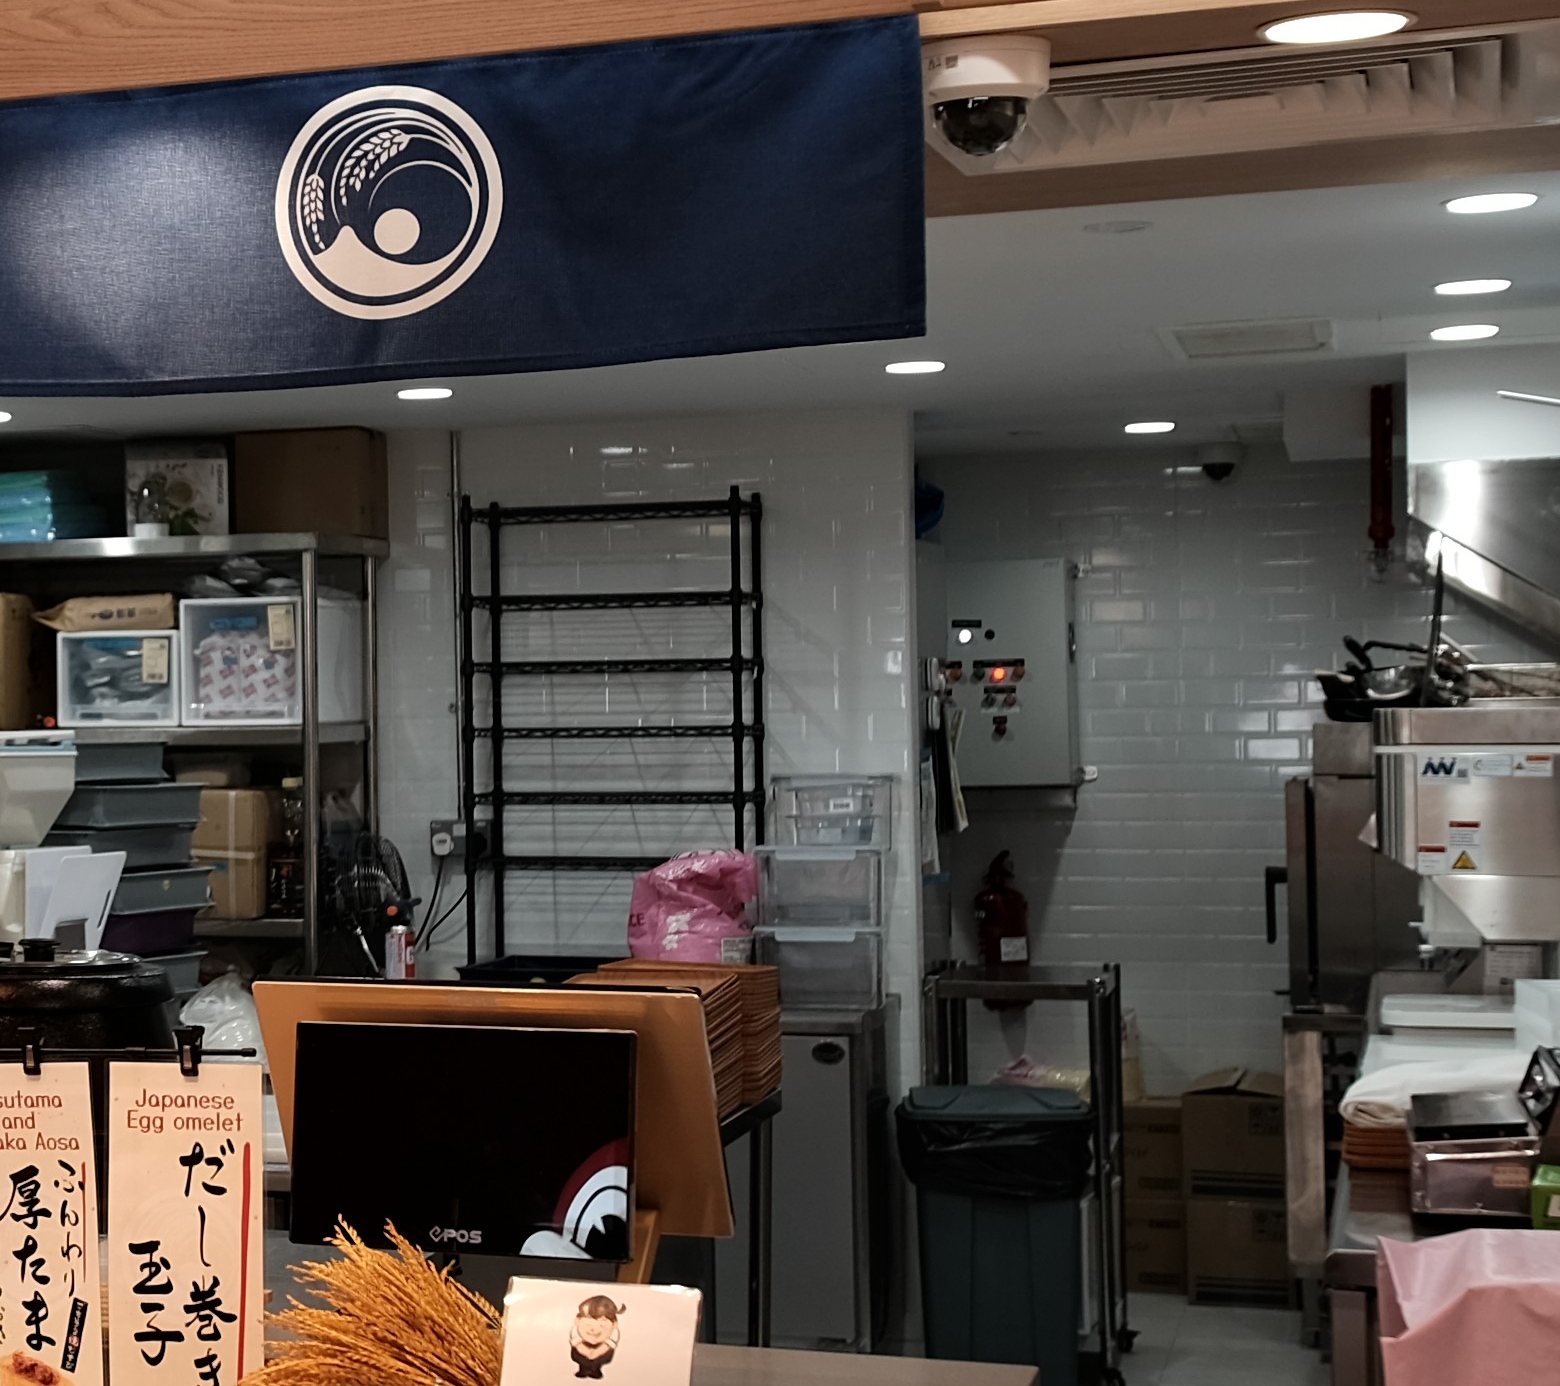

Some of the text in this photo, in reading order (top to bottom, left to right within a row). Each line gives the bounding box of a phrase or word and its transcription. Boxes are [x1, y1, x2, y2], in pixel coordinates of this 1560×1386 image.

[135, 1091, 235, 1113] Japanese
[2, 1111, 36, 1130] and
[127, 1113, 243, 1134] Egg omelet
[36, 1133, 80, 1151] Aosa
[53, 1159, 85, 1297] ふんわり
[127, 1239, 185, 1366] 玉子
